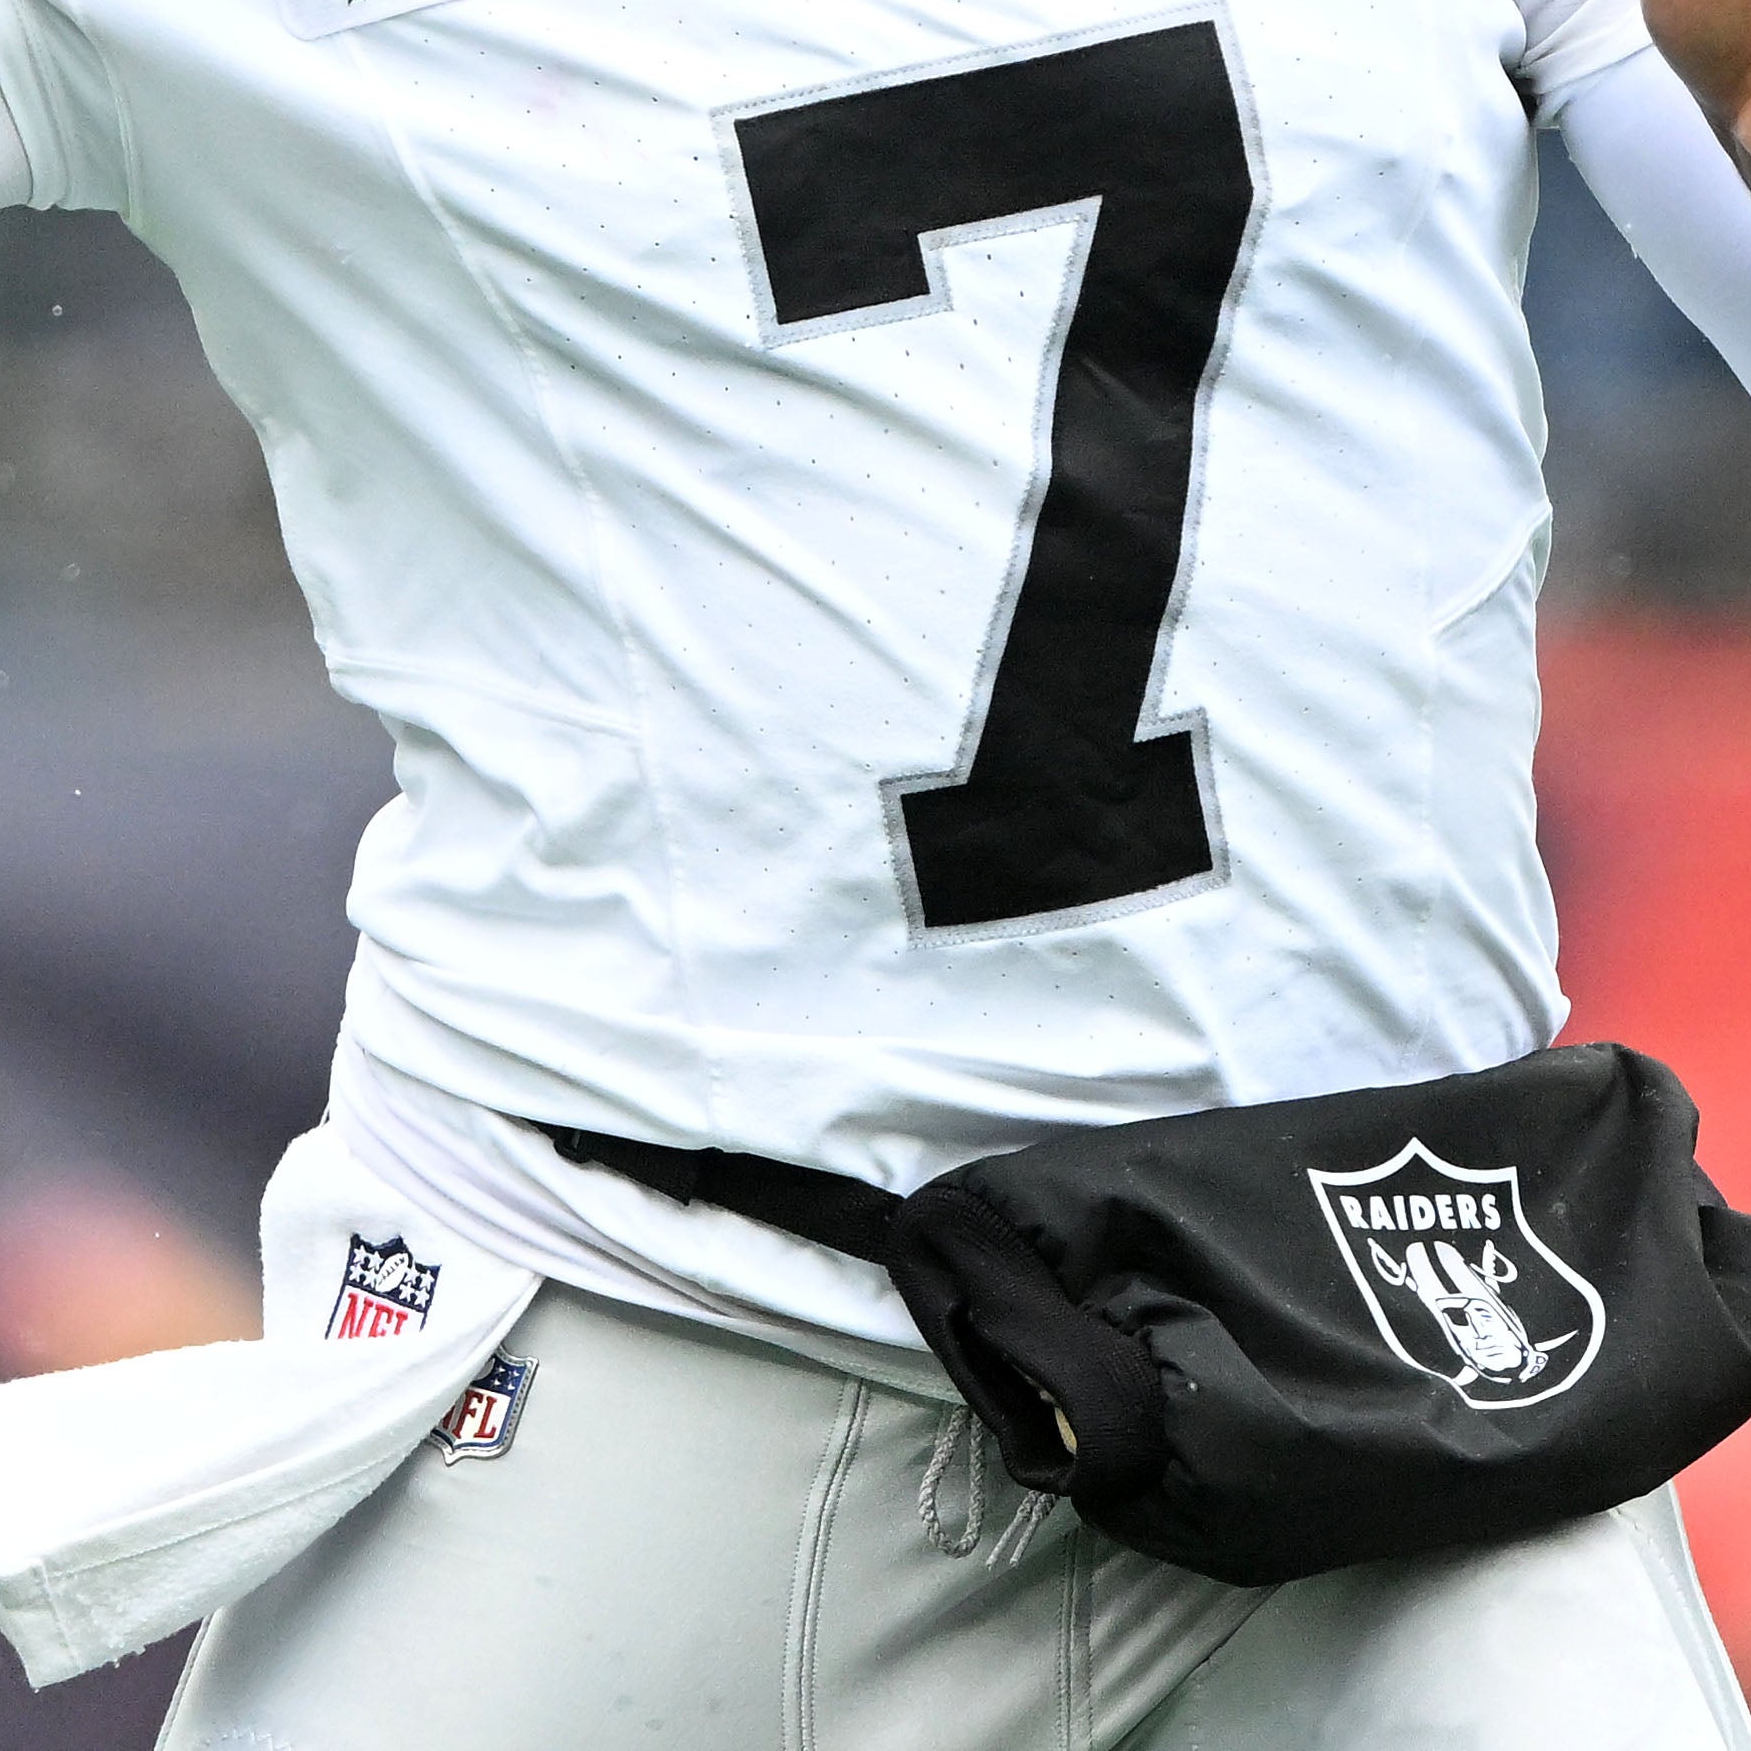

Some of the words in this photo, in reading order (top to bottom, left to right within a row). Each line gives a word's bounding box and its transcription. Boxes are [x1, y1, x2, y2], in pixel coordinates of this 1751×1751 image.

[712, 0, 1271, 947] 7
[1339, 1193, 1501, 1231] RAIDERS
[442, 1389, 498, 1439] FL
